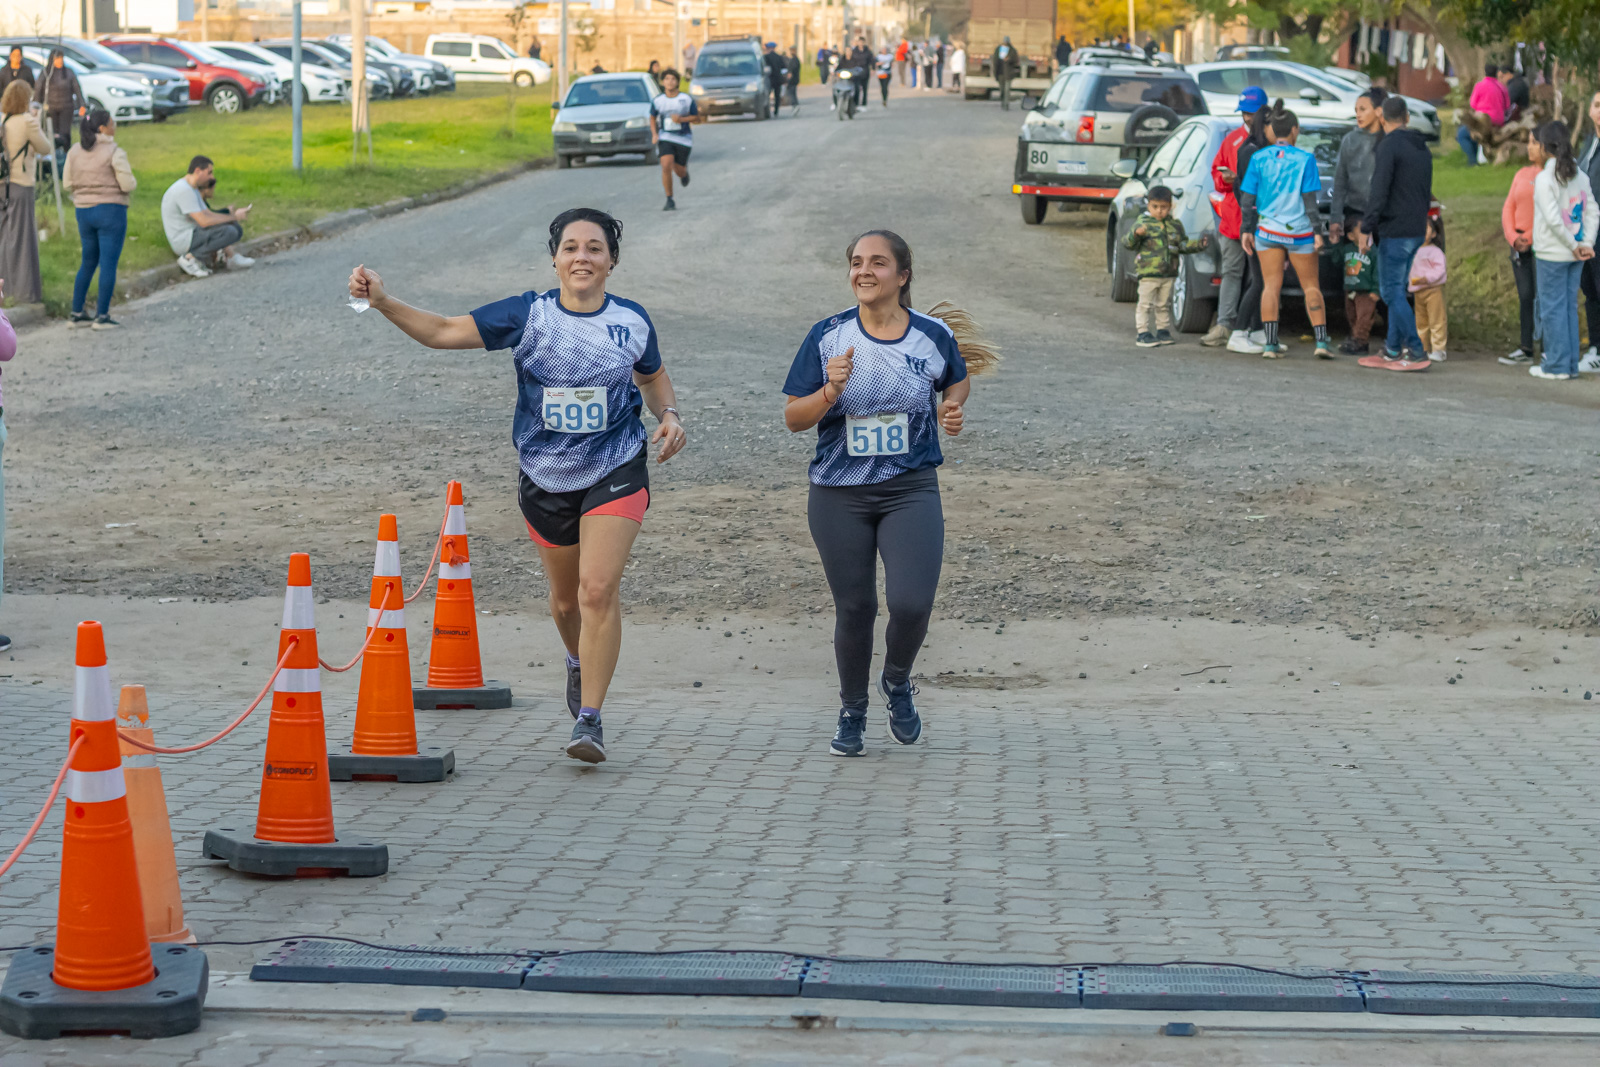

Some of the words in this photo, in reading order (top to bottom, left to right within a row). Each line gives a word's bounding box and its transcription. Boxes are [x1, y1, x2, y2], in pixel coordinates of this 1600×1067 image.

[1031, 150, 1048, 164] 80
[545, 403, 604, 430] 599
[852, 425, 904, 453] 518
